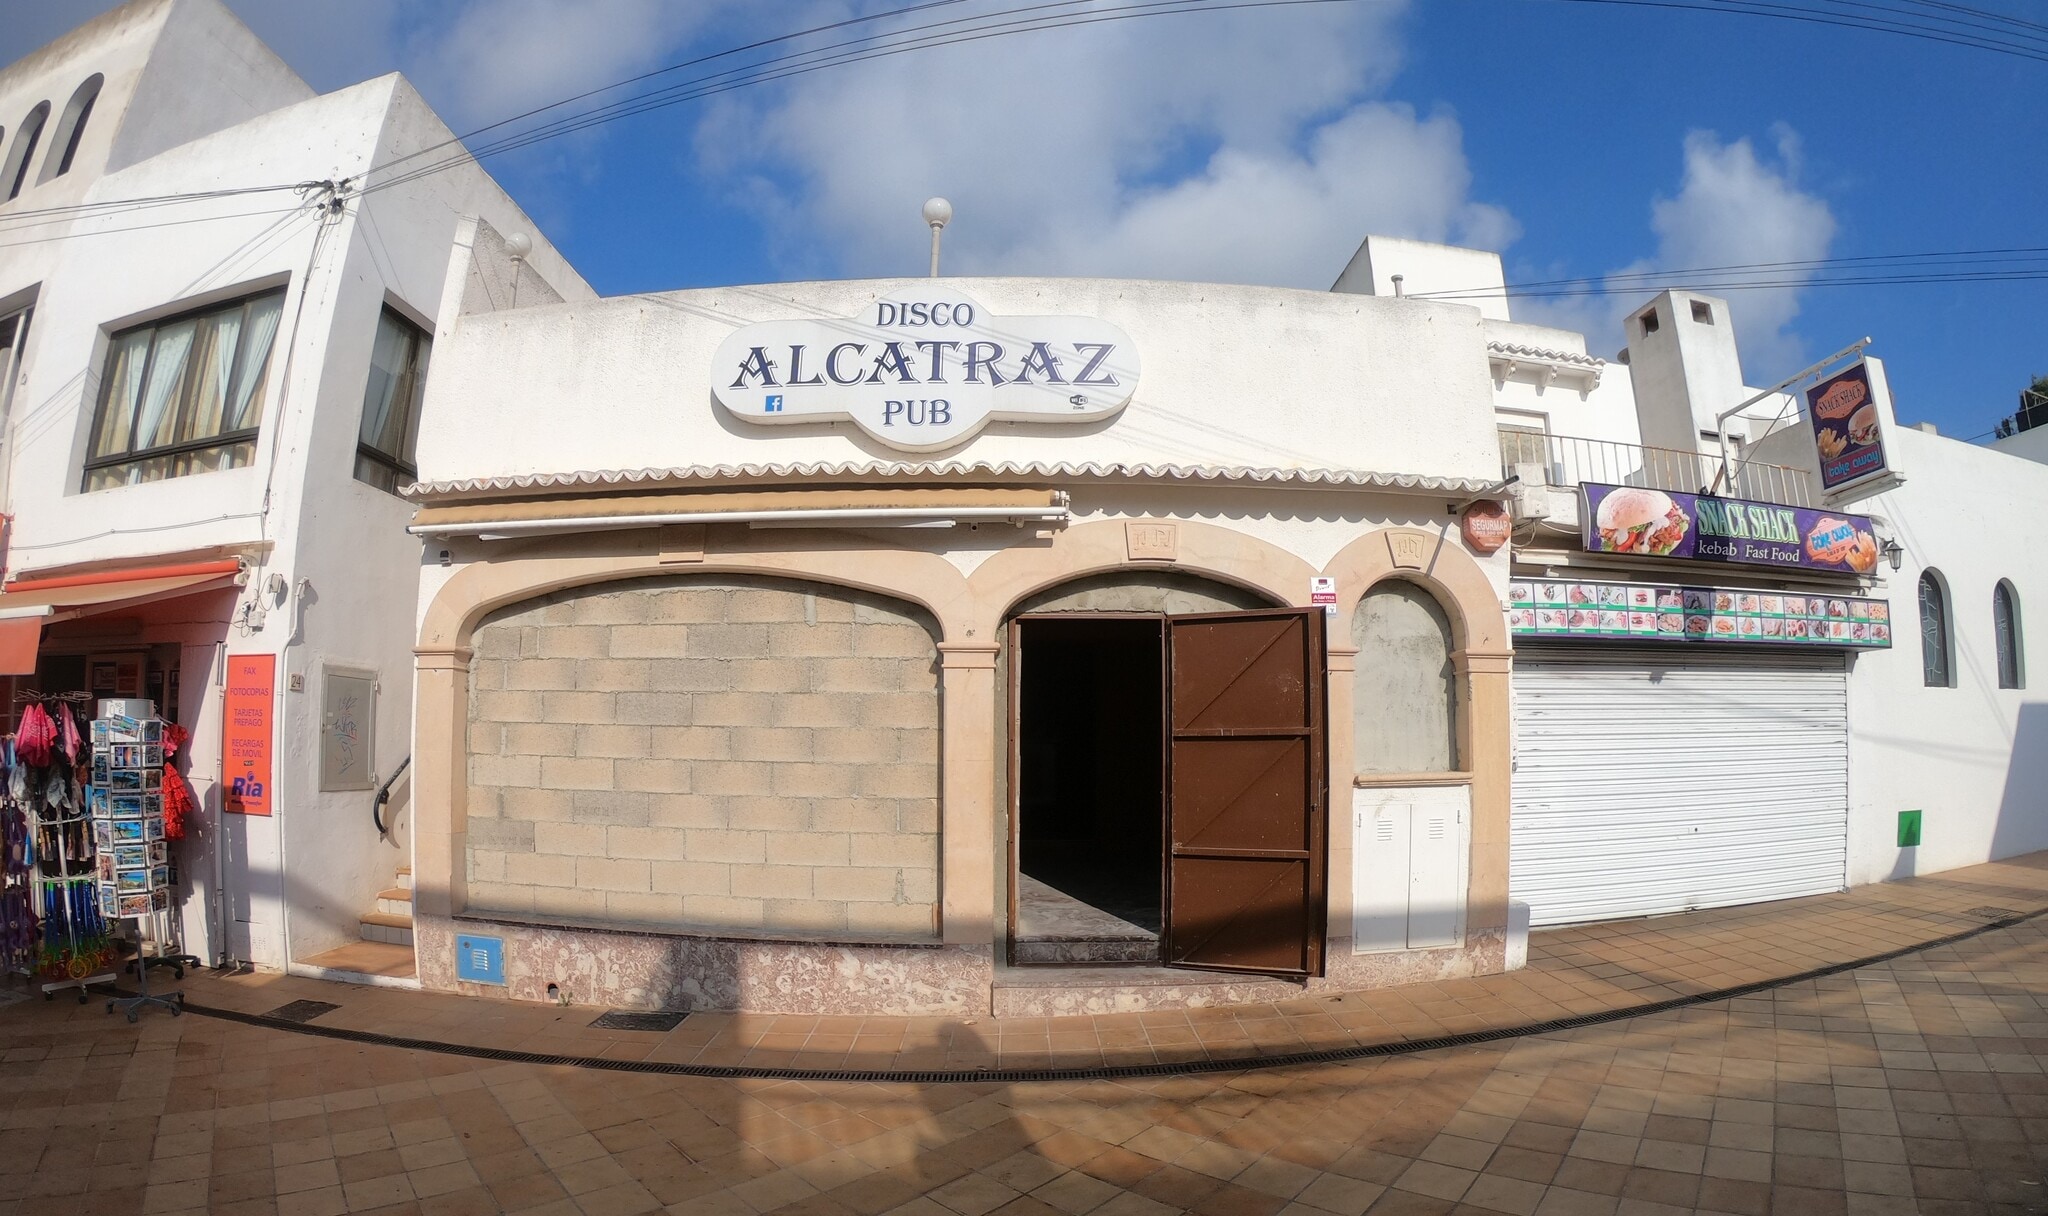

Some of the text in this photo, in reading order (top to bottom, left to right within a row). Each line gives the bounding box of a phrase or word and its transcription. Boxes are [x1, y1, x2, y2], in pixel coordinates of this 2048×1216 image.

[876, 302, 976, 328] DISCO
[728, 340, 1121, 389] ALCATRAZ
[1818, 383, 1864, 416] SNACK SHACK
[883, 399, 953, 427] PUB
[1829, 450, 1880, 477] take away
[1471, 519, 1508, 531] SEGURMAP
[1695, 499, 1800, 544] SNACK SHACK
[1698, 540, 1800, 562] kebab Fast Food
[243, 666, 256, 675] FAX
[291, 675, 301, 688] 24
[229, 687, 269, 697] FOTOCOPIAS
[233, 708, 263, 717] TARJETAS
[233, 718, 263, 727] PREPAGO
[231, 738, 264, 748] RECARGAS
[232, 748, 241, 757] DE
[231, 771, 264, 797] Ria
